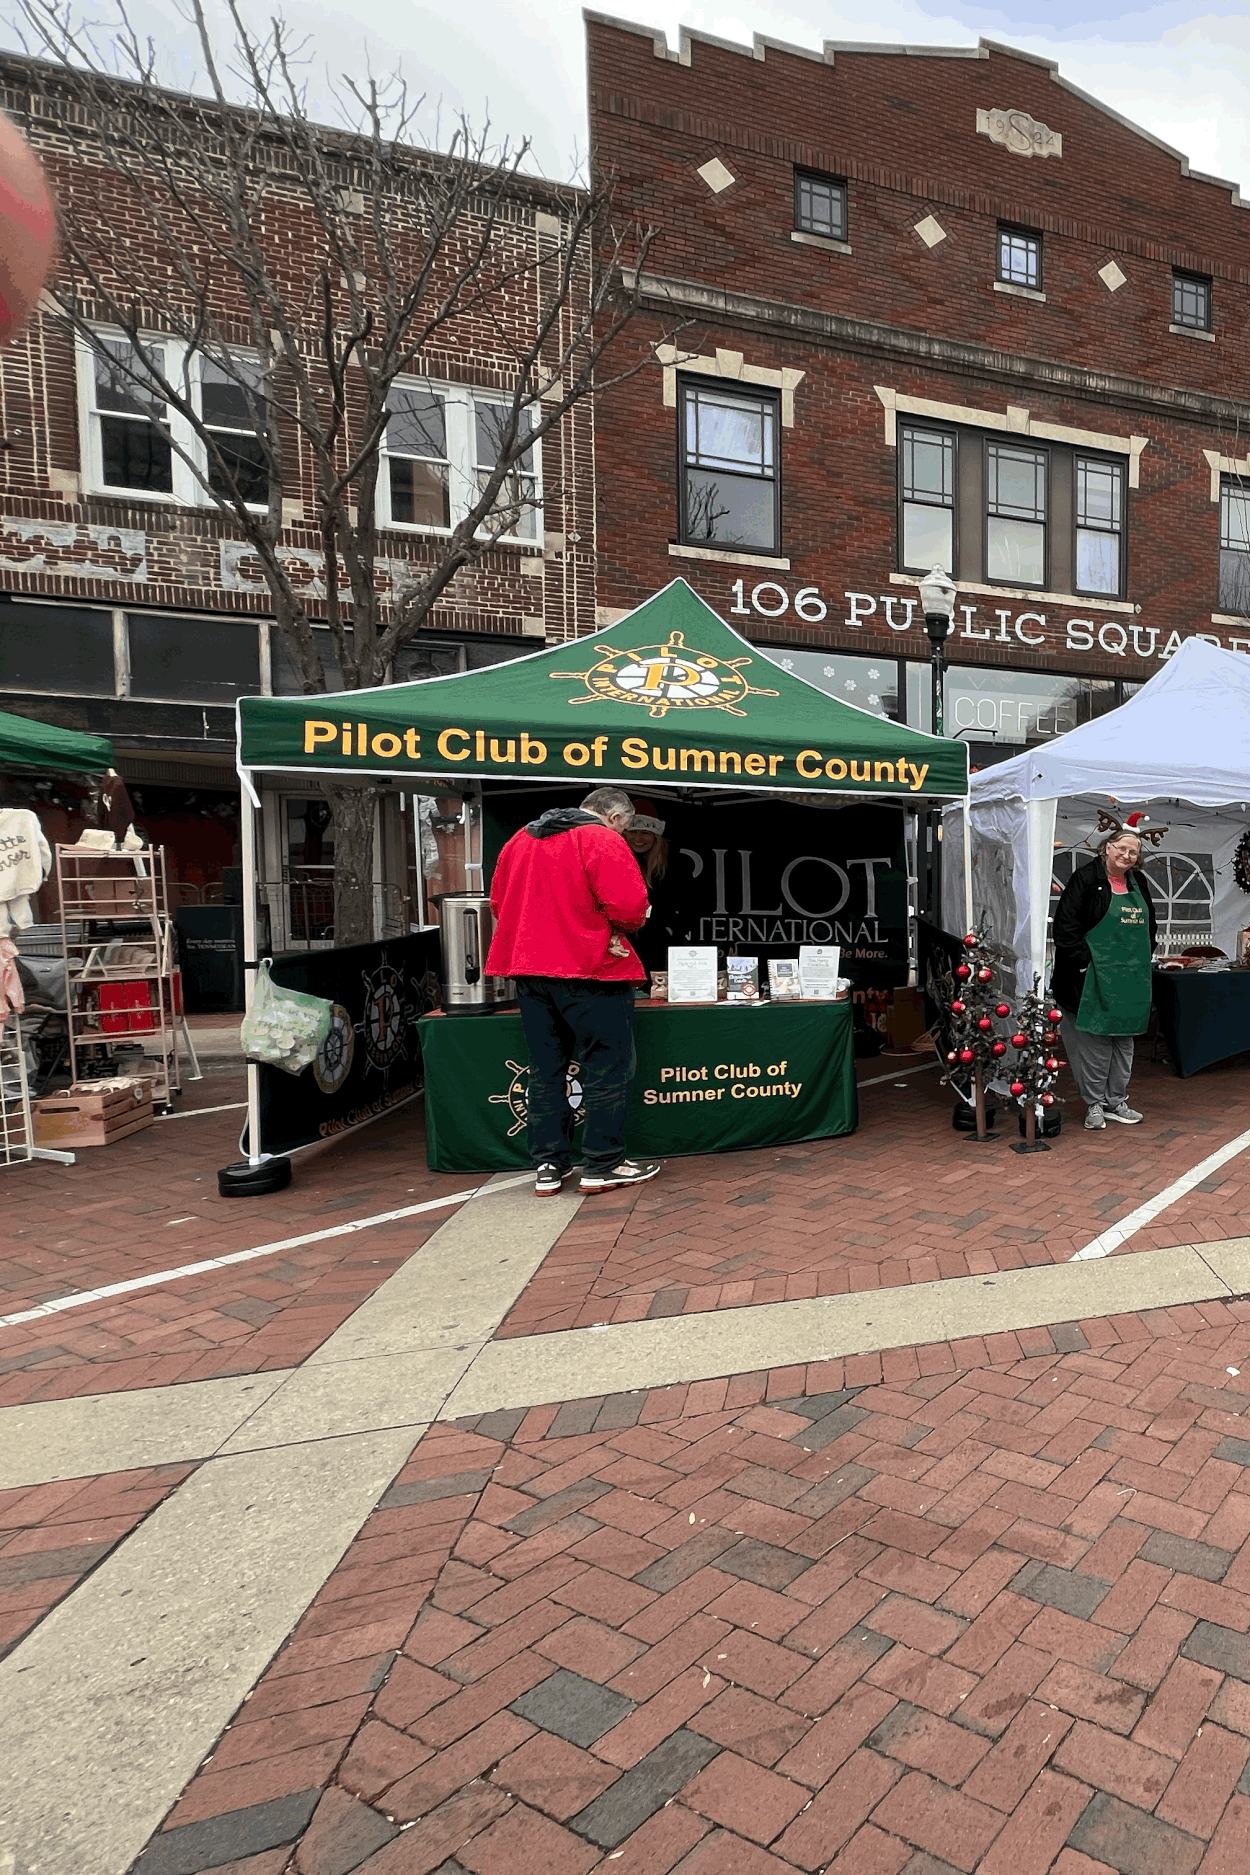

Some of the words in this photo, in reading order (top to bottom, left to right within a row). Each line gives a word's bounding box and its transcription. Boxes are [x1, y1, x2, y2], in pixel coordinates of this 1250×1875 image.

[730, 579, 827, 622] 106
[596, 646, 742, 686] PILOT
[638, 661, 701, 691] P
[591, 676, 741, 706] INTERNATIONAL
[954, 696, 1070, 735] COFFEE
[303, 720, 422, 759] Pilot
[437, 728, 548, 765] Club
[562, 736, 609, 767] of
[621, 737, 785, 776] Sumner
[796, 750, 930, 791] County
[679, 848, 892, 918] ILOT
[685, 917, 889, 944] TERNATIONAL
[855, 949, 888, 959] More.
[661, 1066, 708, 1083] Pilot
[714, 1063, 761, 1080] Club
[766, 1060, 788, 1077] of
[643, 1087, 726, 1106] Sumner
[730, 1081, 803, 1100] County
